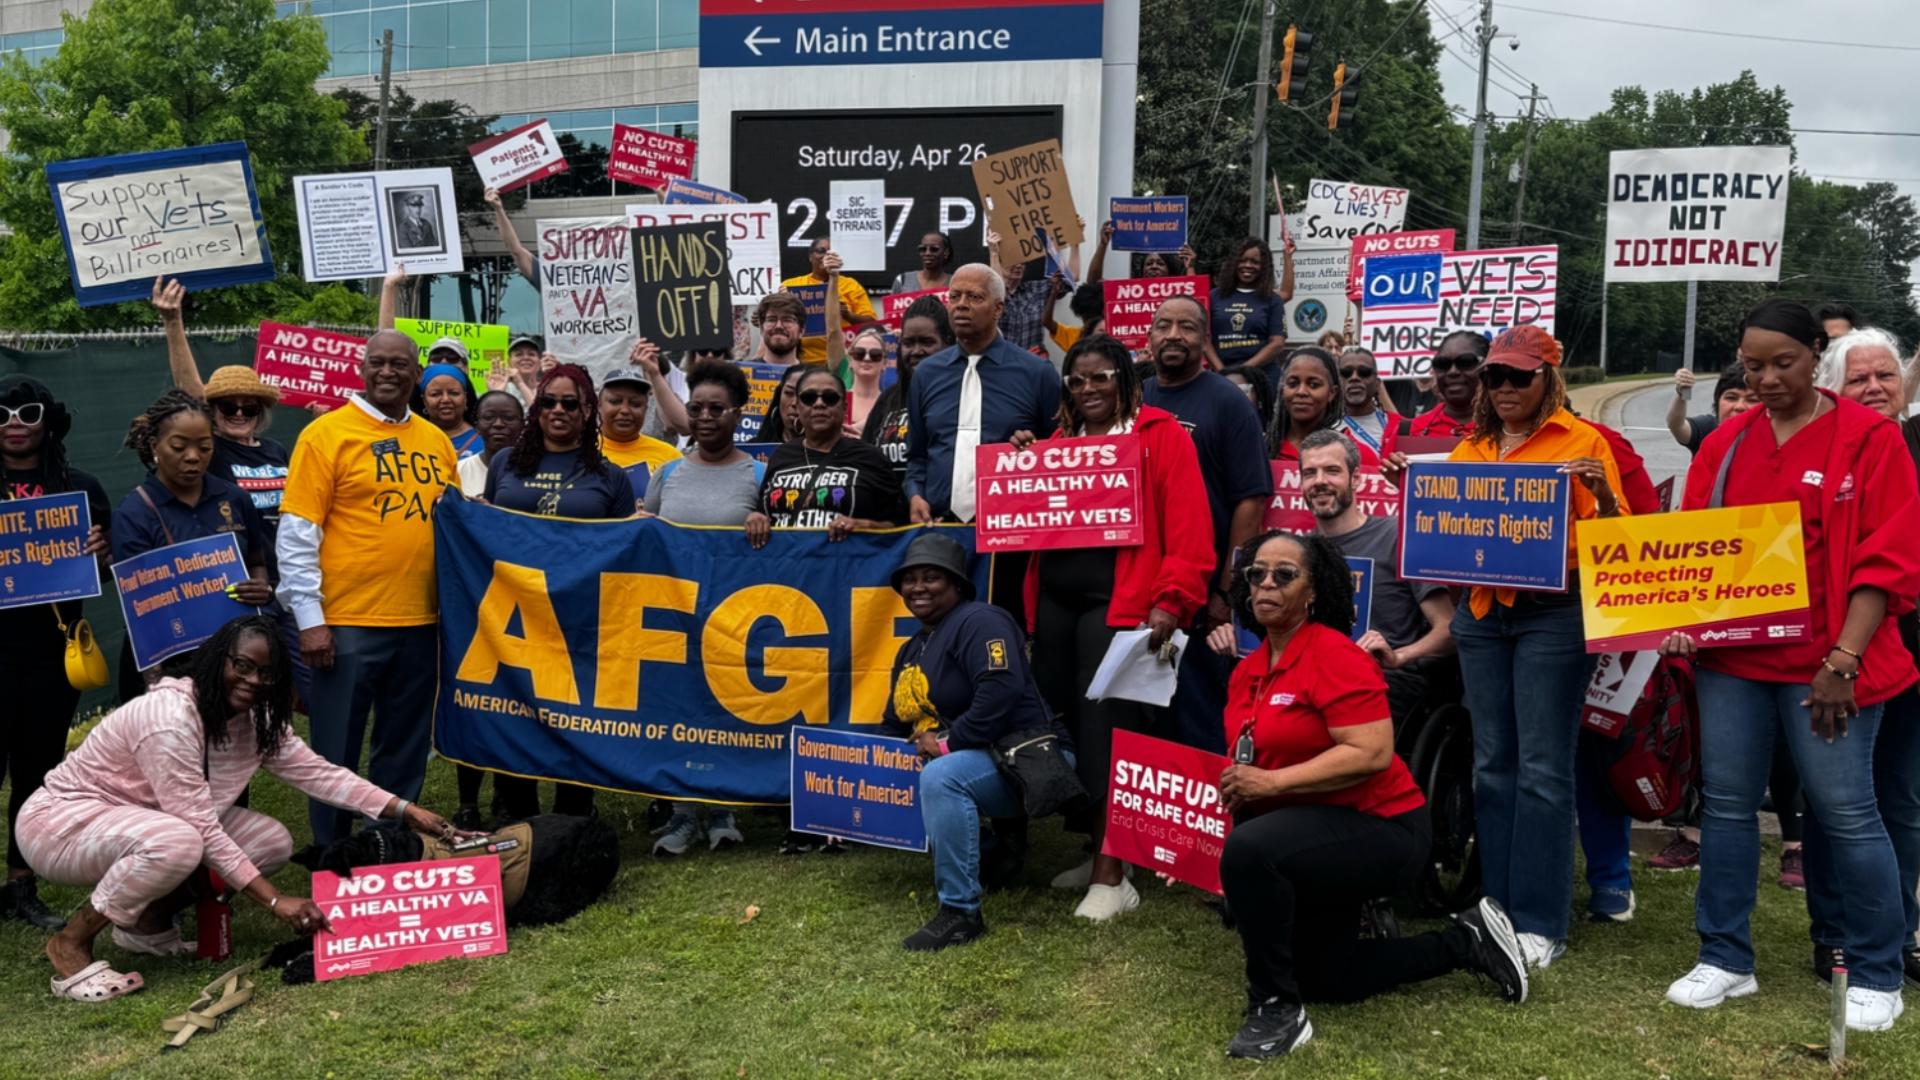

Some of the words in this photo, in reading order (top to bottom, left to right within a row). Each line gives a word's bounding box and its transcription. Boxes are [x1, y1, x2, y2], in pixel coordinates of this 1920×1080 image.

[795, 27, 868, 54] Main
[877, 25, 1010, 52] Entrance
[490, 143, 536, 165] Patients
[618, 144, 626, 152] A
[627, 146, 672, 163] HEALTHY
[674, 157, 687, 167] VA
[623, 130, 645, 145] NO
[648, 137, 684, 154] CUTS
[513, 151, 540, 166] First
[614, 160, 659, 177] HEALTHY
[798, 145, 904, 171] Saturday,
[909, 144, 952, 171] Apr
[958, 143, 987, 166] 26
[990, 147, 1059, 186] SUPPORT
[65, 174, 191, 214] Support
[848, 196, 865, 207] SIC
[1006, 178, 1052, 208] VETS
[1310, 182, 1348, 201] CDC
[1348, 186, 1408, 206] SAVES
[1613, 173, 1783, 202] DEMOCRACY
[81, 217, 128, 241] our
[143, 192, 228, 229] Vets
[835, 208, 878, 219] SEMPRE
[1009, 206, 1054, 235] FIRE
[1154, 201, 1184, 213] Workers
[1669, 205, 1727, 231] NOT
[131, 225, 161, 248] not
[832, 219, 882, 232] TYRRANIS
[1117, 219, 1132, 231] Work
[1134, 219, 1145, 230] for
[1146, 219, 1179, 231] America!
[89, 224, 245, 281] Billionaires!
[542, 225, 630, 261] SUPPORT
[1020, 227, 1066, 257] DOE
[1363, 238, 1391, 252] NO
[1394, 235, 1441, 250] CUTS
[1614, 238, 1778, 267] IDIOCRACY
[640, 230, 724, 284] HANDS
[1336, 255, 1346, 265] of
[542, 263, 630, 287] VETERANS
[1369, 271, 1436, 299] OUR
[1453, 254, 1549, 295] VETS
[548, 289, 569, 299] AND
[570, 285, 609, 318] VA
[1116, 284, 1144, 300] NO
[1148, 281, 1196, 298] CUTS
[656, 280, 721, 339] OFF!
[1112, 304, 1122, 314] A
[1439, 296, 1541, 328] NEED
[416, 321, 483, 338] SUPPORT
[550, 315, 633, 335] WORKERS!
[1371, 326, 1449, 352] MORE
[273, 330, 307, 349] NO
[312, 336, 369, 361] CUTS
[265, 349, 276, 361] A
[280, 352, 345, 374] HEALTHY
[259, 372, 329, 395] HEALTHY
[375, 451, 447, 486] AFGE
[995, 450, 1037, 473] NO
[1043, 444, 1118, 469] CUTS
[988, 481, 1002, 496] A
[1007, 474, 1096, 494] HEALTHY
[1101, 473, 1129, 488] VA
[1414, 475, 1461, 503] STAND,
[1465, 476, 1510, 505] UNITE,
[1514, 478, 1559, 504] FIGHT
[1270, 495, 1285, 509] A
[34, 505, 79, 530] FIGHT
[986, 510, 1075, 530] HEALTHY
[1080, 508, 1132, 525] VETS
[1415, 510, 1435, 533] for
[1437, 511, 1495, 538] Workers
[1498, 513, 1554, 545] Rights!
[24, 536, 82, 566] Rights!
[174, 545, 237, 575] Dedicated
[1590, 543, 1630, 566] VA
[1638, 537, 1743, 563] Nurses
[180, 572, 229, 600] Worker!
[1594, 565, 1714, 588] Protecting
[1595, 586, 1708, 608] America's
[1714, 582, 1796, 600] Heroes
[453, 688, 536, 720] AMERICAN
[538, 707, 641, 739] FEDERATION
[645, 725, 667, 740] OF
[671, 723, 784, 750] GOVERNMENT
[797, 735, 869, 765] Government
[872, 744, 924, 773] Workers
[804, 770, 835, 796] Work
[837, 776, 855, 799] for
[857, 778, 914, 807] America!
[1114, 759, 1184, 800] STAFF
[1185, 779, 1223, 815] UP!
[1113, 788, 1142, 812] FOR
[1144, 799, 1182, 824] SAFE
[1184, 810, 1225, 839] CARE
[1111, 810, 1133, 829] End
[1135, 818, 1165, 839] Crisis
[1168, 827, 1194, 849] Care
[336, 873, 386, 898] NO
[393, 865, 476, 891] CUTS
[327, 905, 345, 920] A
[351, 893, 453, 917] HEALTHY
[458, 890, 489, 906] VA
[326, 928, 431, 956] HEALTHY
[436, 921, 494, 941] VETS
